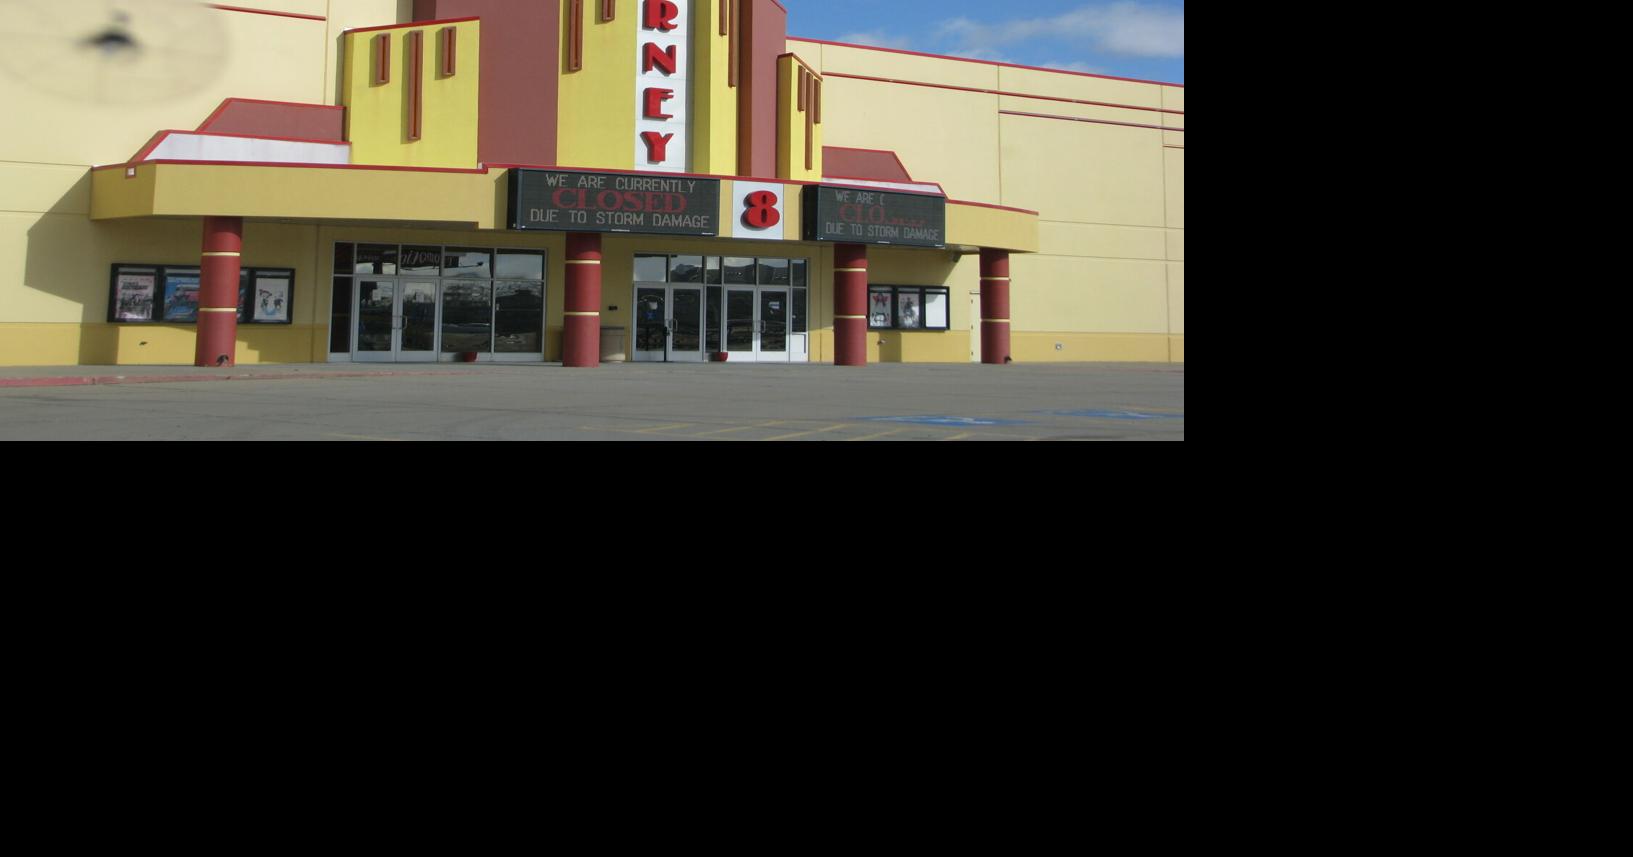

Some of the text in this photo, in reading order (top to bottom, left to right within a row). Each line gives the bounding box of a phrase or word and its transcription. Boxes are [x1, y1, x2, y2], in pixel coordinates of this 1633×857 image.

[545, 173, 696, 193] WE ARE CURRENTLY
[551, 188, 688, 213] CLOSED
[835, 190, 849, 202] WE
[856, 192, 875, 205] ARE
[530, 208, 710, 228] DUE TO STORM DAMAGE
[740, 190, 780, 231] 8
[825, 222, 940, 240] DUE TO STORM DAMAGE
